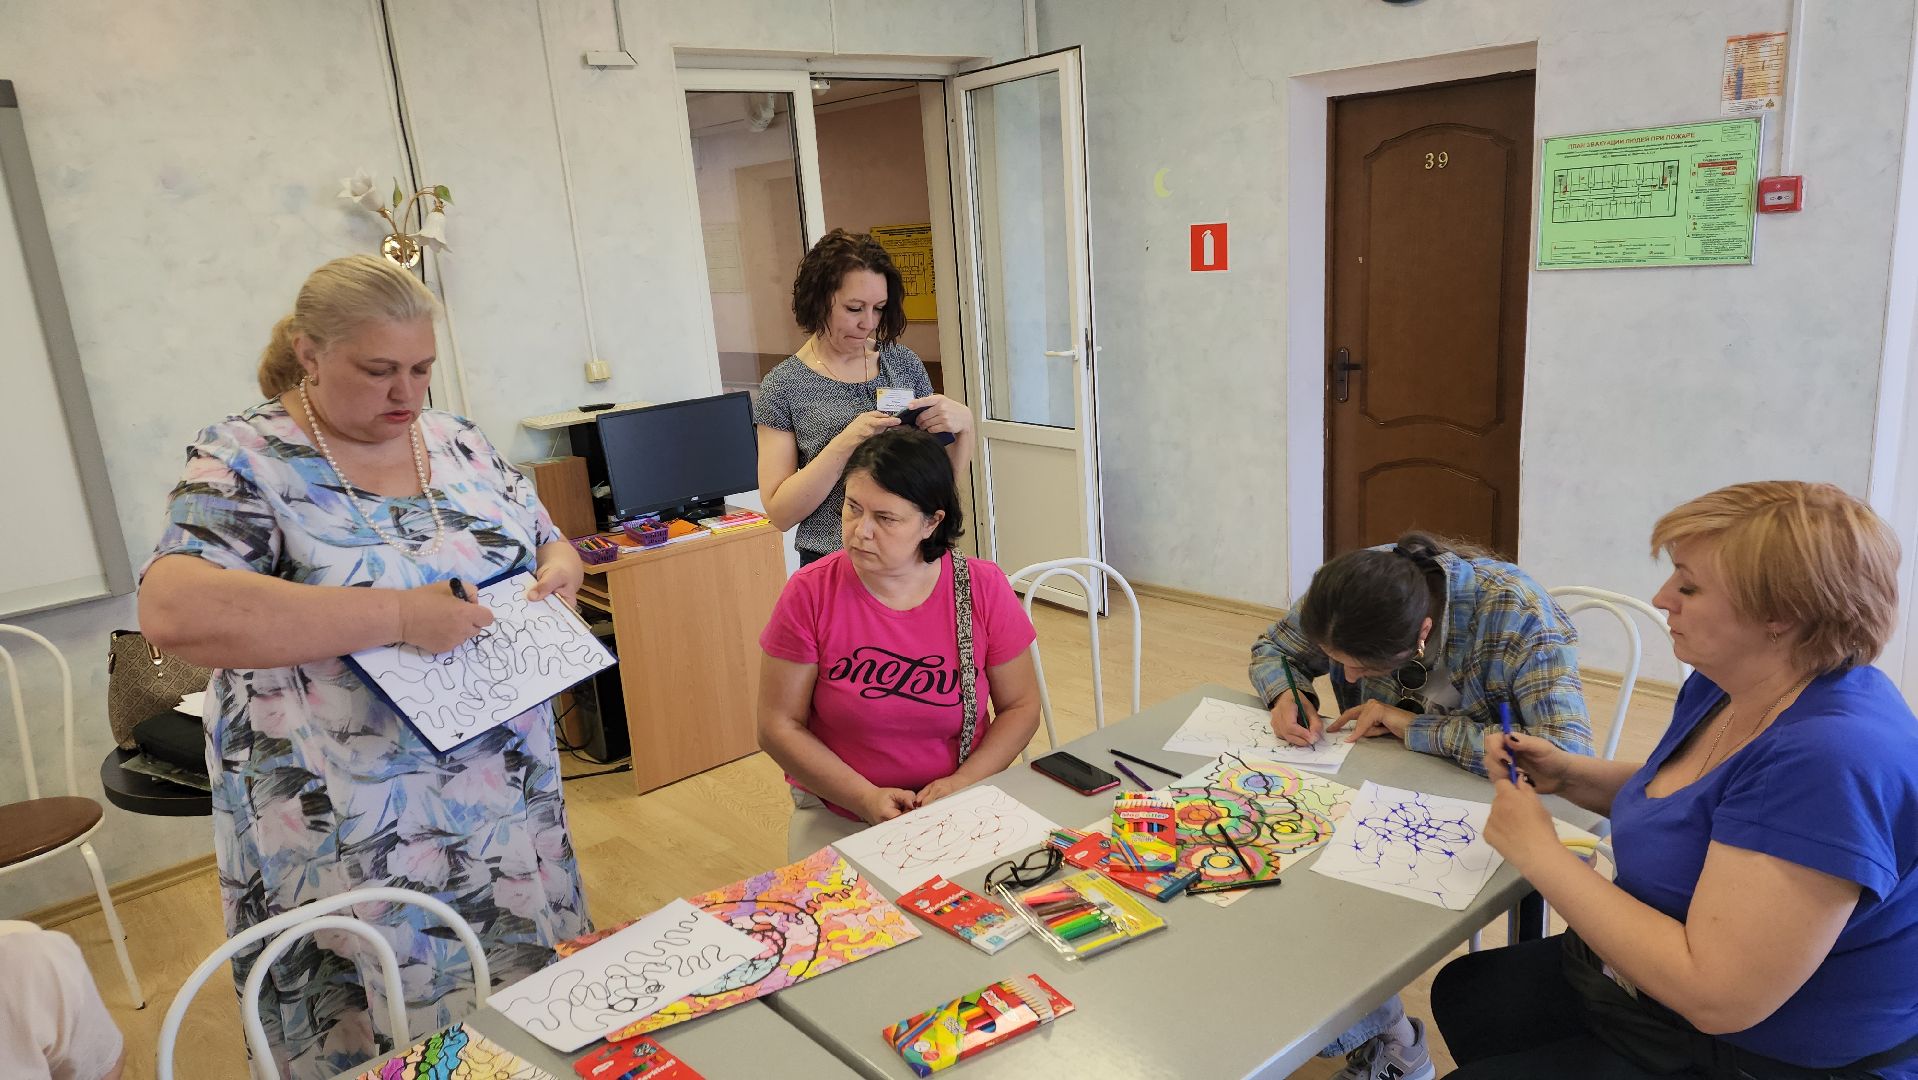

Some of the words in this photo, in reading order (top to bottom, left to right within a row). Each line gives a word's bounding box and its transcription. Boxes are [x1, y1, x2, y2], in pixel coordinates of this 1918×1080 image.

[1651, 134, 1665, 142] ПРИ
[1666, 132, 1696, 141] ПОЖАРЕ
[1424, 152, 1449, 170] 39
